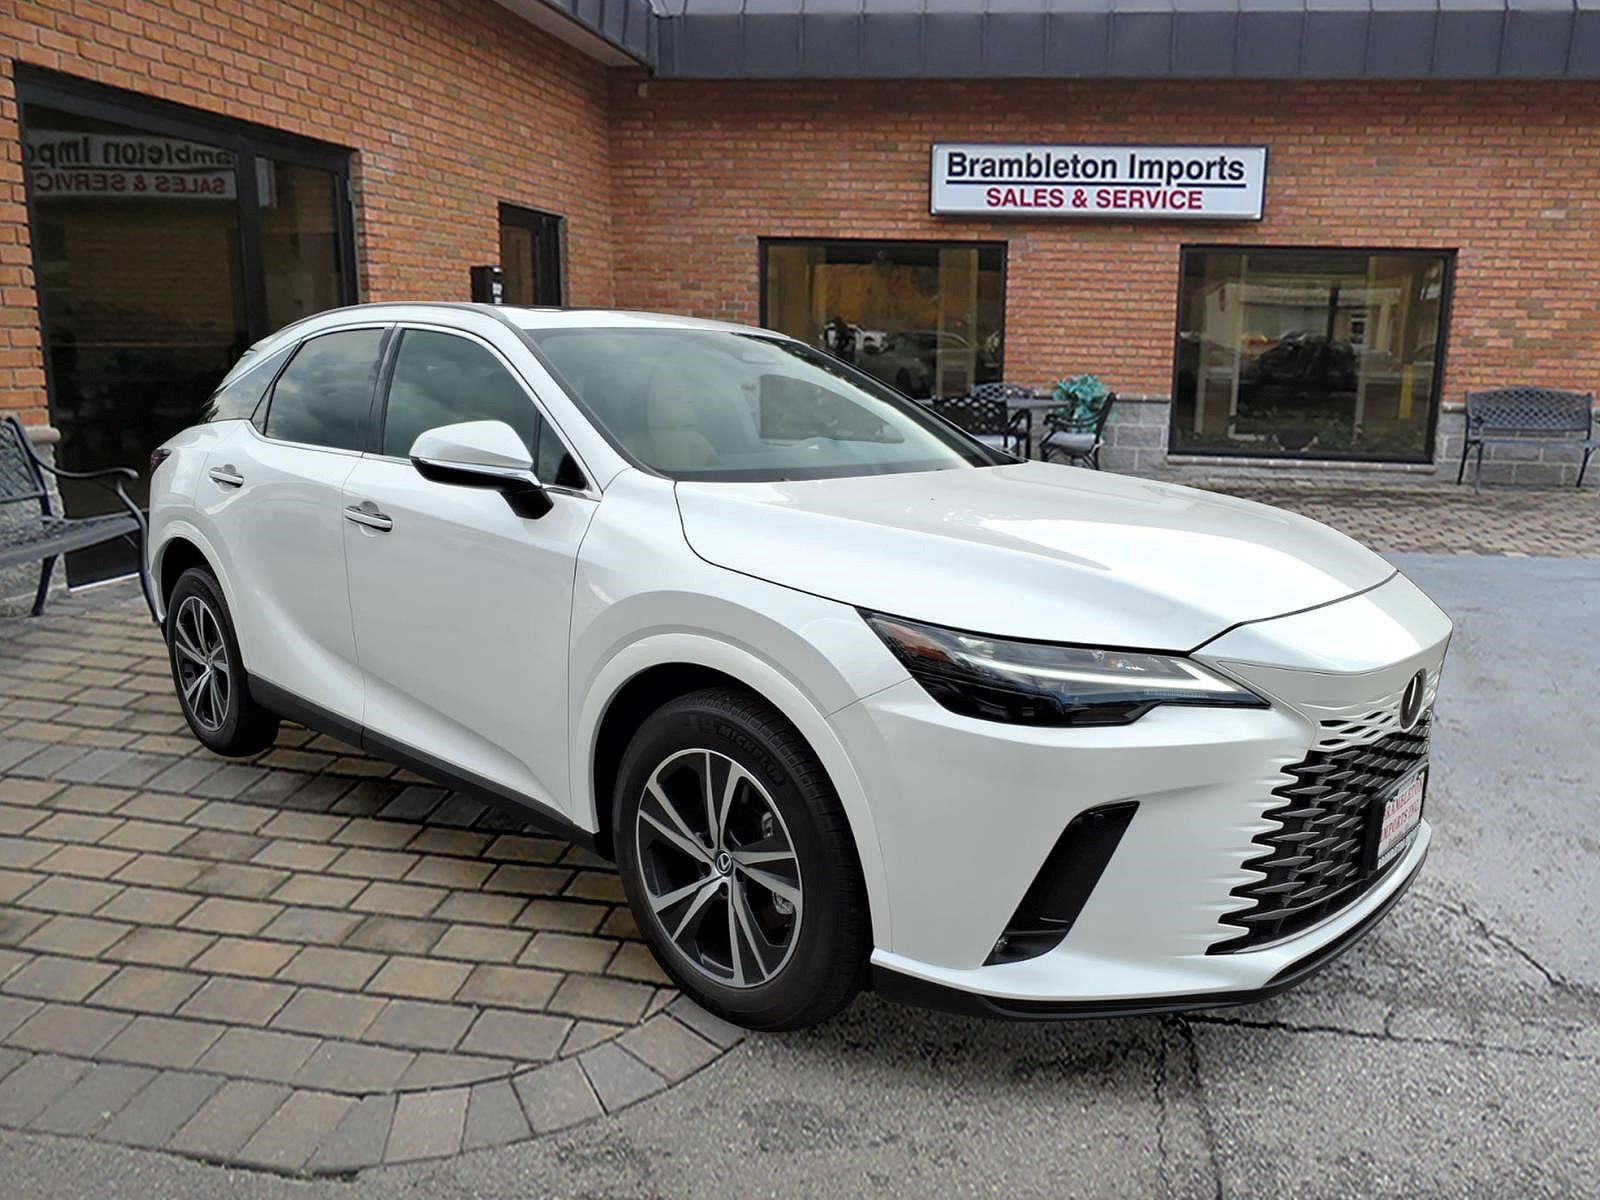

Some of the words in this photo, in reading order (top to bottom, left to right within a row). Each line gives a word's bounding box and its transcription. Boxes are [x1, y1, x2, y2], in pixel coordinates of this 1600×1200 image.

[947, 151, 1117, 180] Brambleton
[1129, 154, 1245, 186] Imports
[986, 187, 1064, 208] SALES
[1072, 189, 1088, 208] &
[1096, 189, 1203, 210] SERVICE
